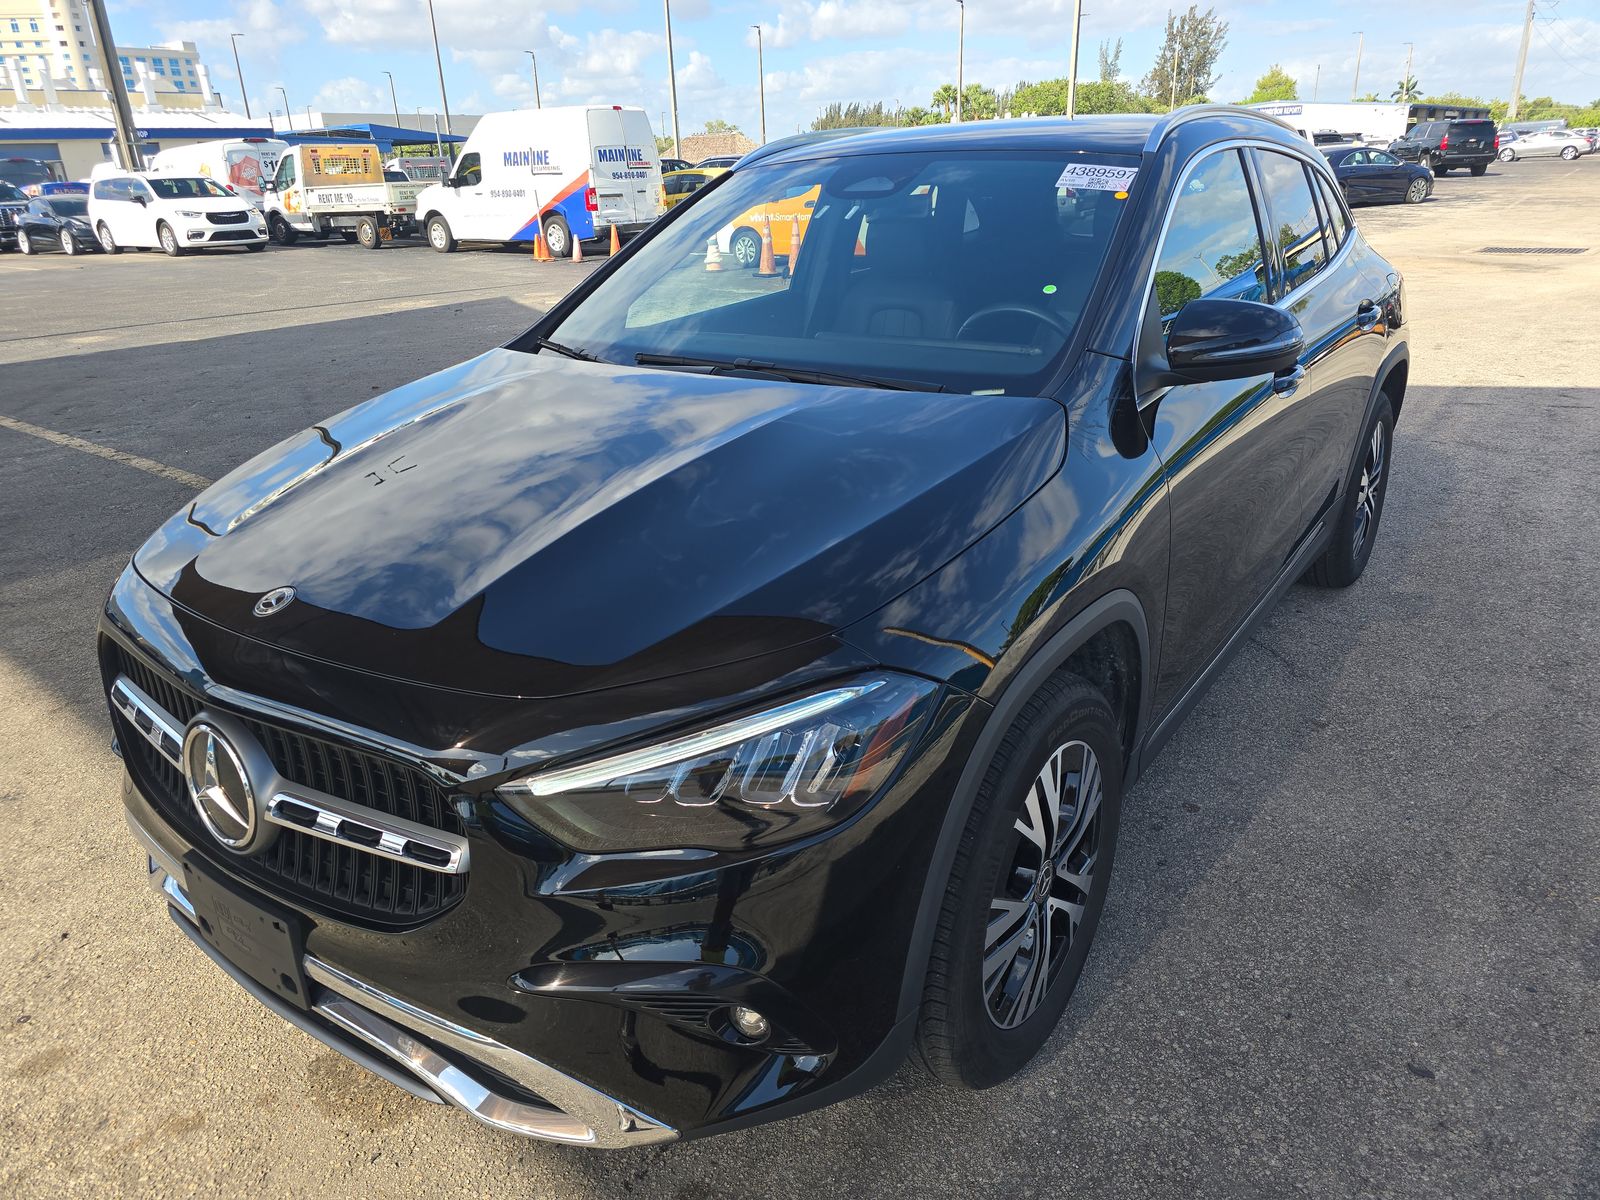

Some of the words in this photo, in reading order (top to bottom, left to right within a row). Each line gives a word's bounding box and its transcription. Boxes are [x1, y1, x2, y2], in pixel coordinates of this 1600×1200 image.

[1066, 166, 1138, 180] 4389597
[317, 193, 333, 204] RENT
[334, 193, 344, 203] ME
